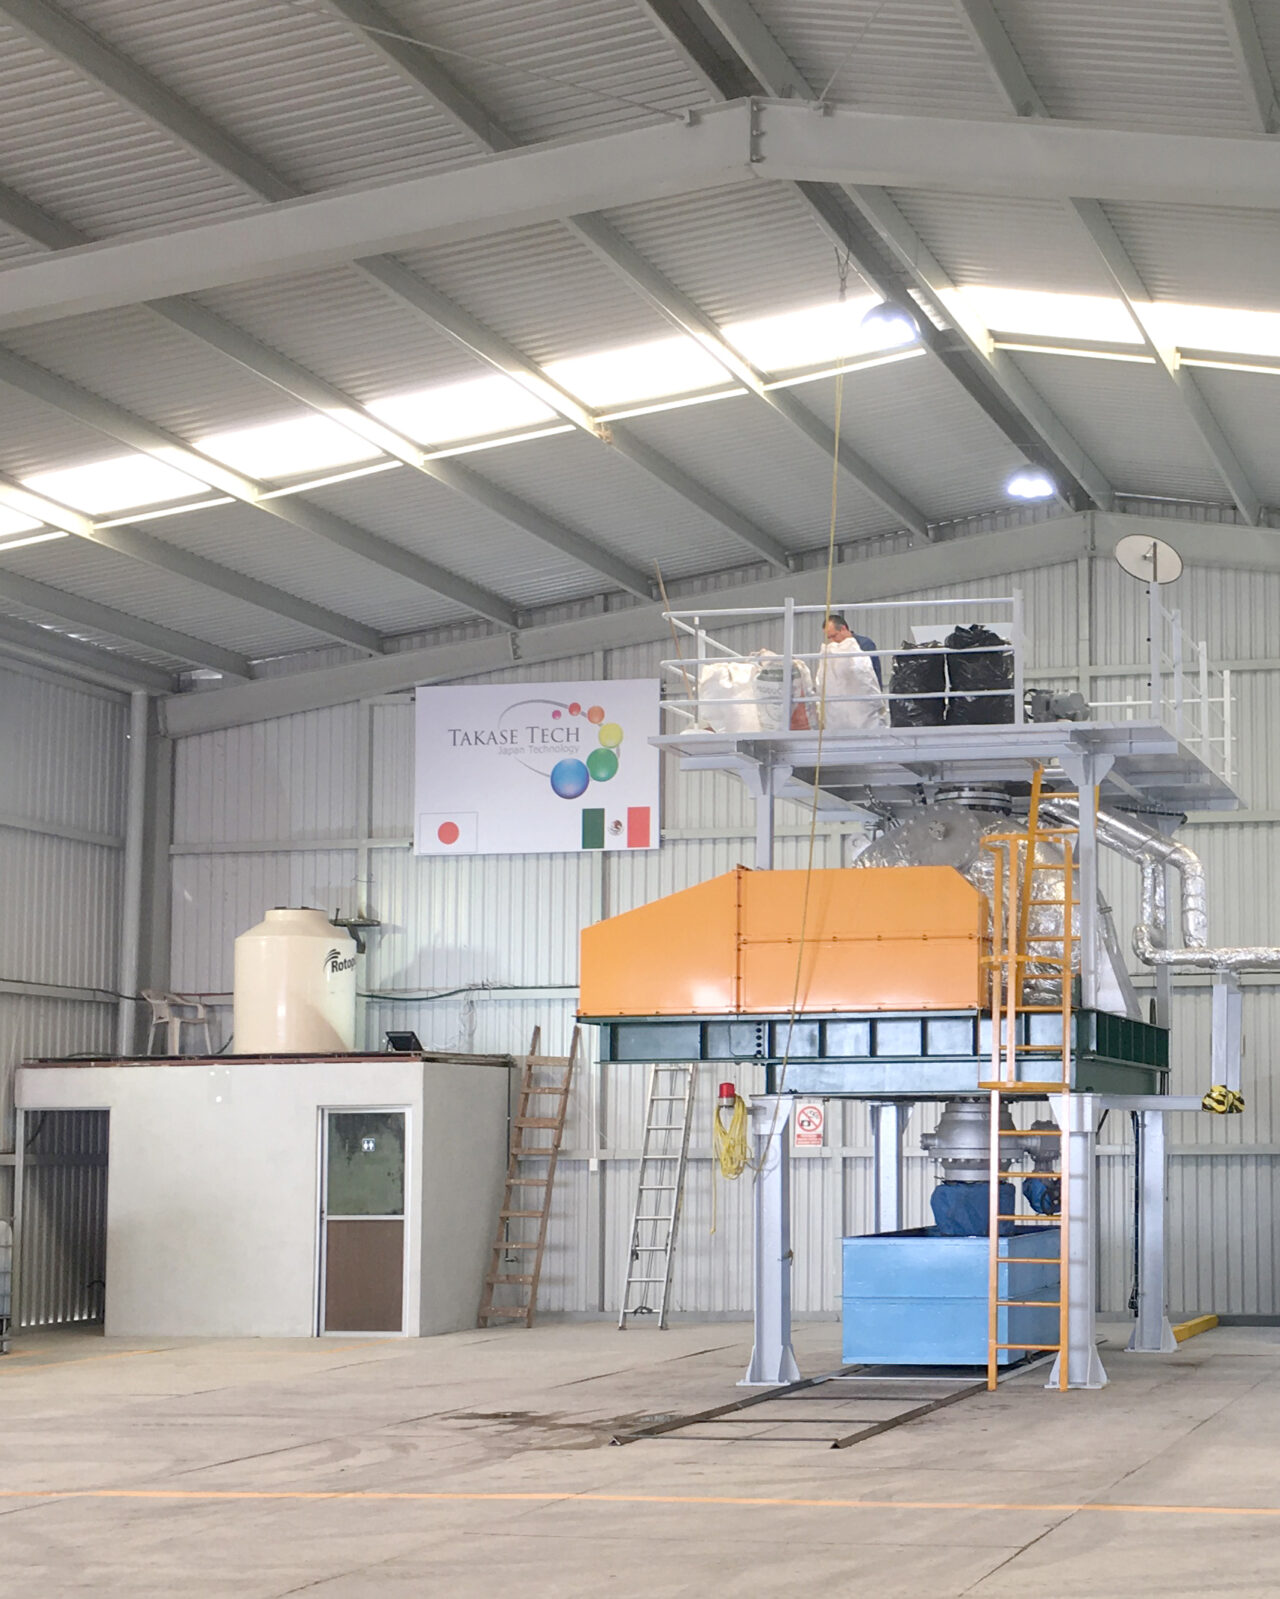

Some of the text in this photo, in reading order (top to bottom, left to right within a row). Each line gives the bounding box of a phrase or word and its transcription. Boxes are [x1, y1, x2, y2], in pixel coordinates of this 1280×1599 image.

[448, 726, 579, 746] TAKASE TECH
[498, 744, 579, 755] Japan Technology
